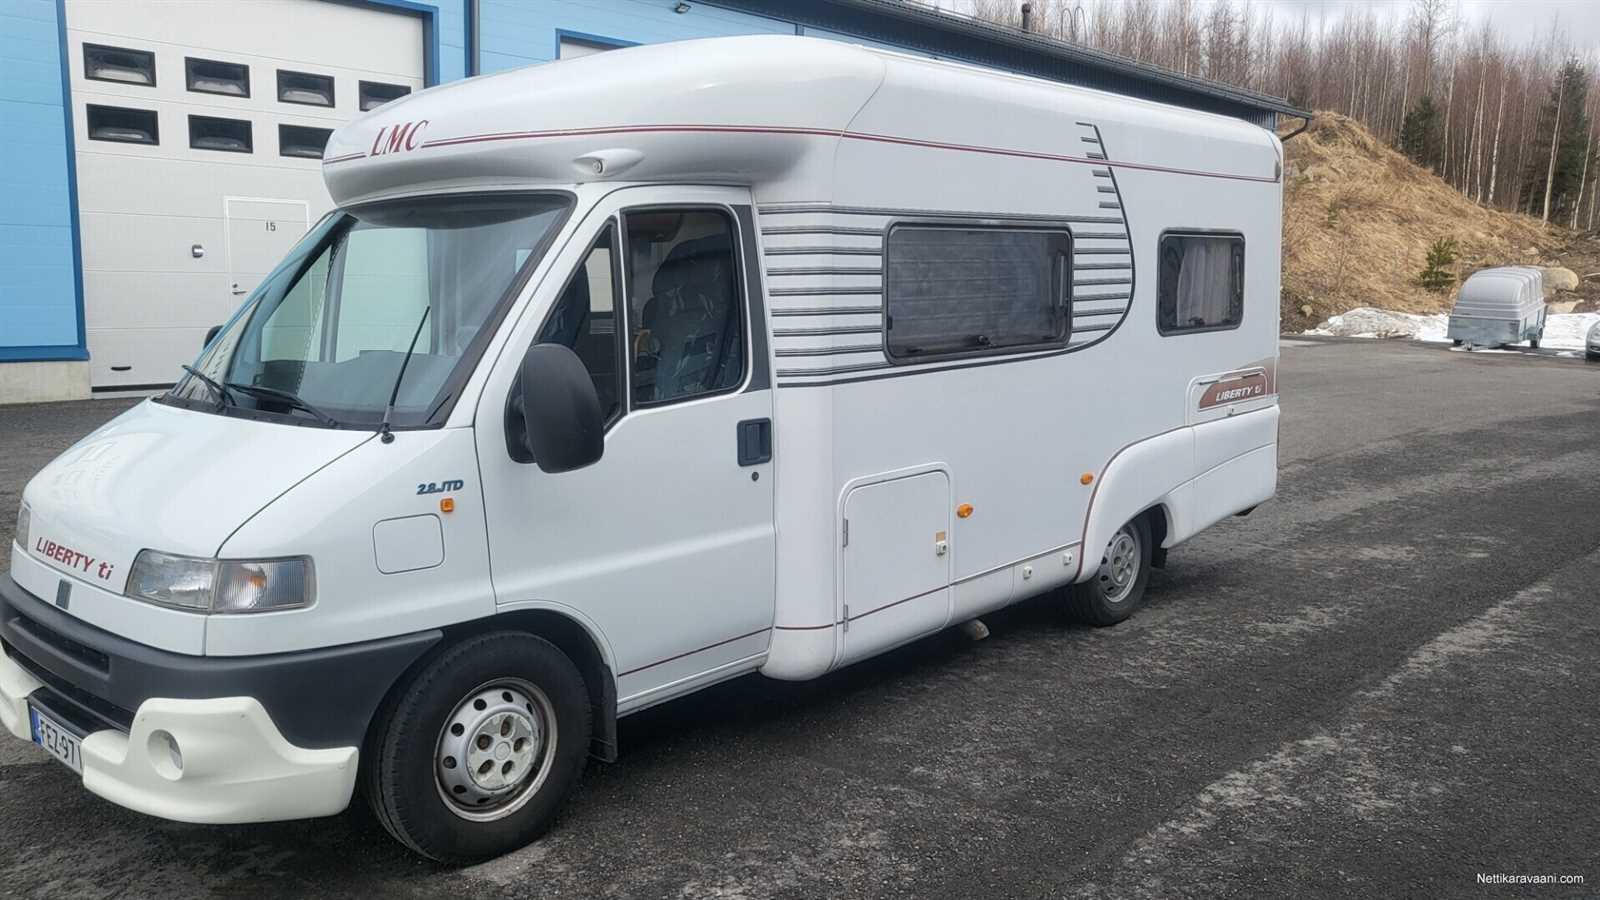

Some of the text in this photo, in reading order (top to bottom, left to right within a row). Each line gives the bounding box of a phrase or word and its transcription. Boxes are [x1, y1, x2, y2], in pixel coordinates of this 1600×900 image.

[371, 120, 429, 156] LMC
[265, 221, 276, 231] 15
[1216, 386, 1254, 401] LIBERTY
[36, 537, 115, 580] LIBERTY ti
[40, 719, 82, 769] FEZ-97
